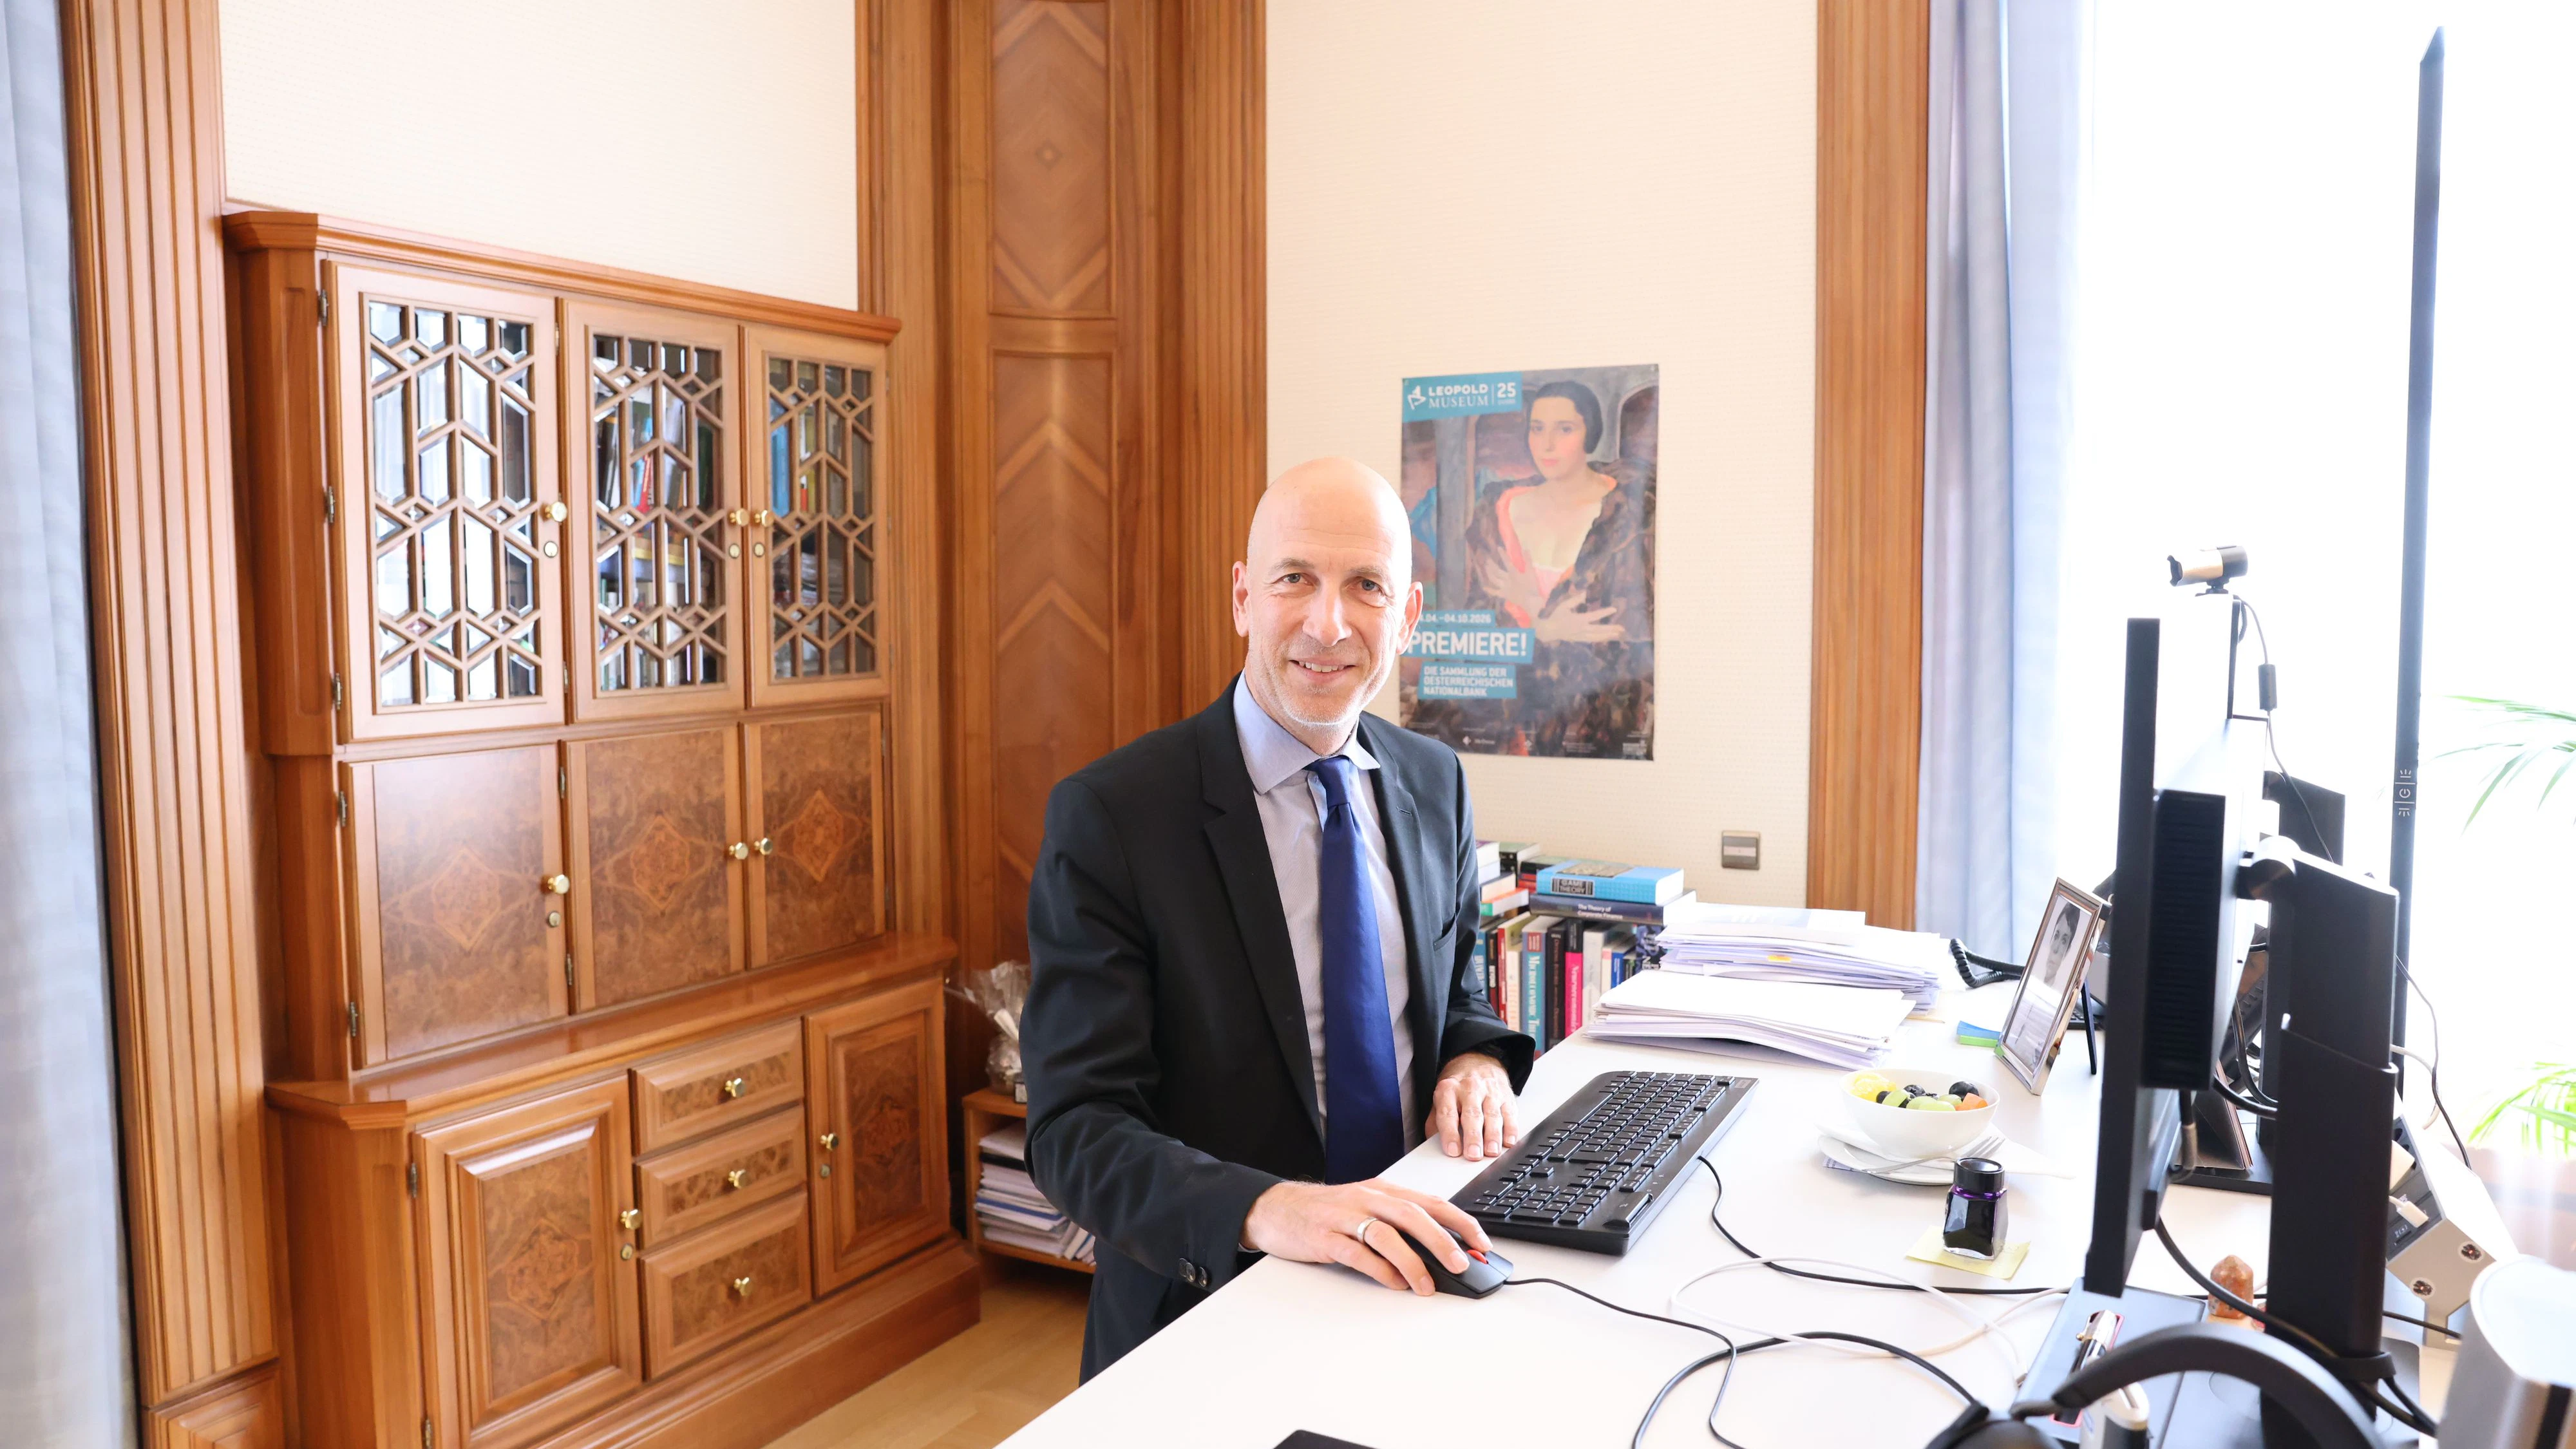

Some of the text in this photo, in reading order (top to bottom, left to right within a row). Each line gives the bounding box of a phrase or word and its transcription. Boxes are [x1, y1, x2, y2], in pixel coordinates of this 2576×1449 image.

[1428, 383, 1489, 397] LEOPOLD
[1497, 382, 1517, 398] 25
[1428, 395, 1489, 409] MUSEUM
[1407, 630, 1527, 656] PREMIERE!
[1424, 666, 1507, 677] DIE SAMMLUNG DER
[1424, 676, 1513, 687] OESTERREICHISCHEN
[1424, 687, 1487, 696] NATIONALBANK
[1560, 879, 1582, 887] GAME
